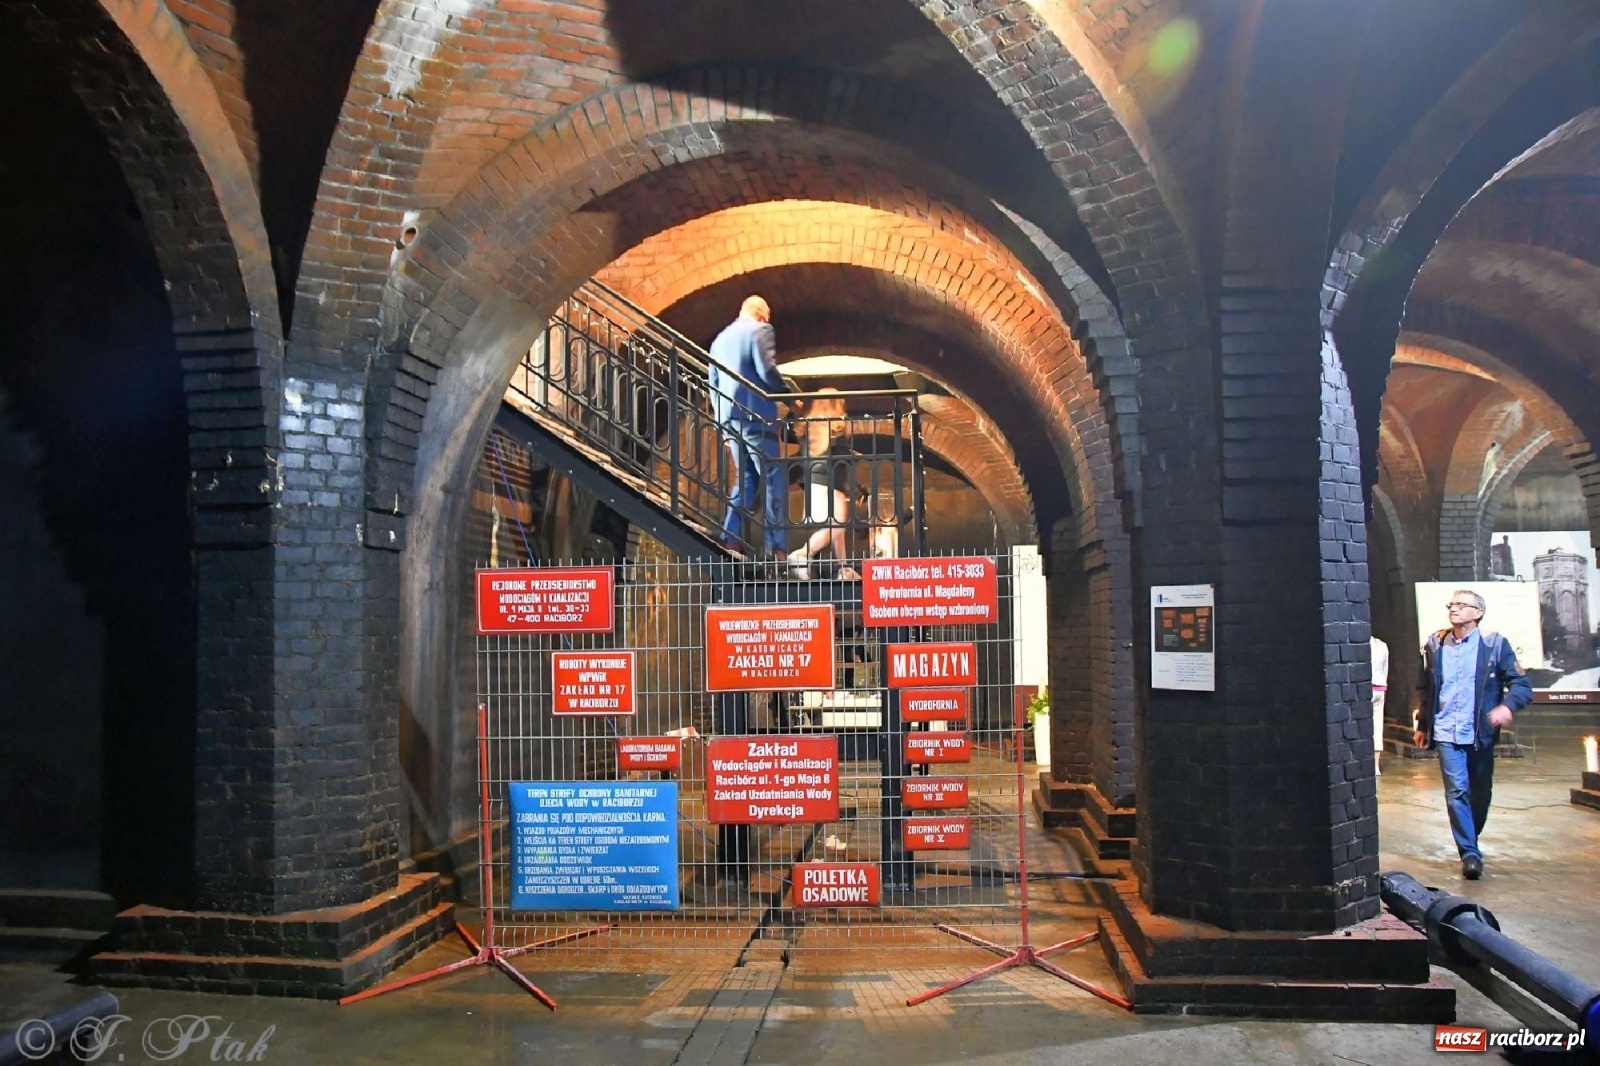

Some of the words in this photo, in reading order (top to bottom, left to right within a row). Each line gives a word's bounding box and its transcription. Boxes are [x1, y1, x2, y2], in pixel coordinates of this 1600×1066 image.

[894, 565, 928, 579] Racibórz
[931, 565, 944, 578] tel.
[947, 564, 984, 578] 415-3033
[492, 581, 526, 590] REJONOWE
[531, 579, 596, 590] PRZEDSIĘBIORSTWO
[549, 592, 589, 603] KANALIZACJI
[879, 586, 922, 601] Hydrofornia
[924, 586, 933, 597] ul.
[935, 584, 975, 599] Magdaleny
[869, 605, 898, 618] Osobom
[900, 605, 923, 619] obcym
[926, 605, 947, 619] wstęp
[949, 604, 989, 618] wzbroniony
[544, 614, 583, 622] RACIBÓRZ
[775, 631, 812, 642] KANALIZACJI
[736, 645, 742, 653] W
[747, 644, 804, 653] KATOWICACH
[559, 659, 587, 669] ROBOTY
[589, 659, 626, 669] WYKONUJE
[728, 655, 773, 668] ZAKŁAD
[779, 655, 794, 667] NR
[798, 654, 811, 666] 17
[894, 652, 969, 678] MAGAZYN
[751, 669, 799, 677] RACIBORZU
[560, 685, 595, 695] ZAKŁAD
[599, 685, 611, 695] NR
[615, 685, 625, 695] 17
[568, 699, 578, 708] W
[580, 698, 618, 707] RACIBORZU
[909, 699, 958, 710] HYDROFORNIA
[748, 742, 797, 756] Zakład
[908, 739, 940, 748] ZBIORNIK
[943, 739, 964, 747] WODY
[939, 748, 943, 756] I
[712, 760, 772, 772] Wodociągów
[775, 759, 778, 769] i
[780, 758, 832, 771] Kanalizacji
[716, 775, 756, 786] Racibórz
[759, 774, 772, 784] ul.
[774, 774, 795, 786] 1-go
[798, 774, 821, 786] Maja
[824, 774, 829, 783] 8
[527, 789, 547, 798] TEREN
[550, 789, 575, 798] STREFY
[579, 788, 611, 797] OCHRONY
[614, 788, 657, 797] SANITARNEJ
[907, 784, 939, 792] ZBIORNIK
[942, 783, 963, 792] WODY
[714, 790, 746, 800] Zakład
[749, 789, 804, 799] Uzdatniania
[806, 789, 832, 800] Wody
[935, 793, 944, 801] III
[567, 798, 588, 807] WODY
[603, 798, 644, 807] RACIBORZU
[749, 804, 803, 818] Dyrekcja
[562, 813, 573, 822] POD
[908, 826, 940, 834] ZBIORNIK
[943, 824, 965, 833] WODY
[924, 835, 934, 843] NR
[804, 869, 867, 885] POLETKA
[802, 887, 868, 902] OSADOWE
